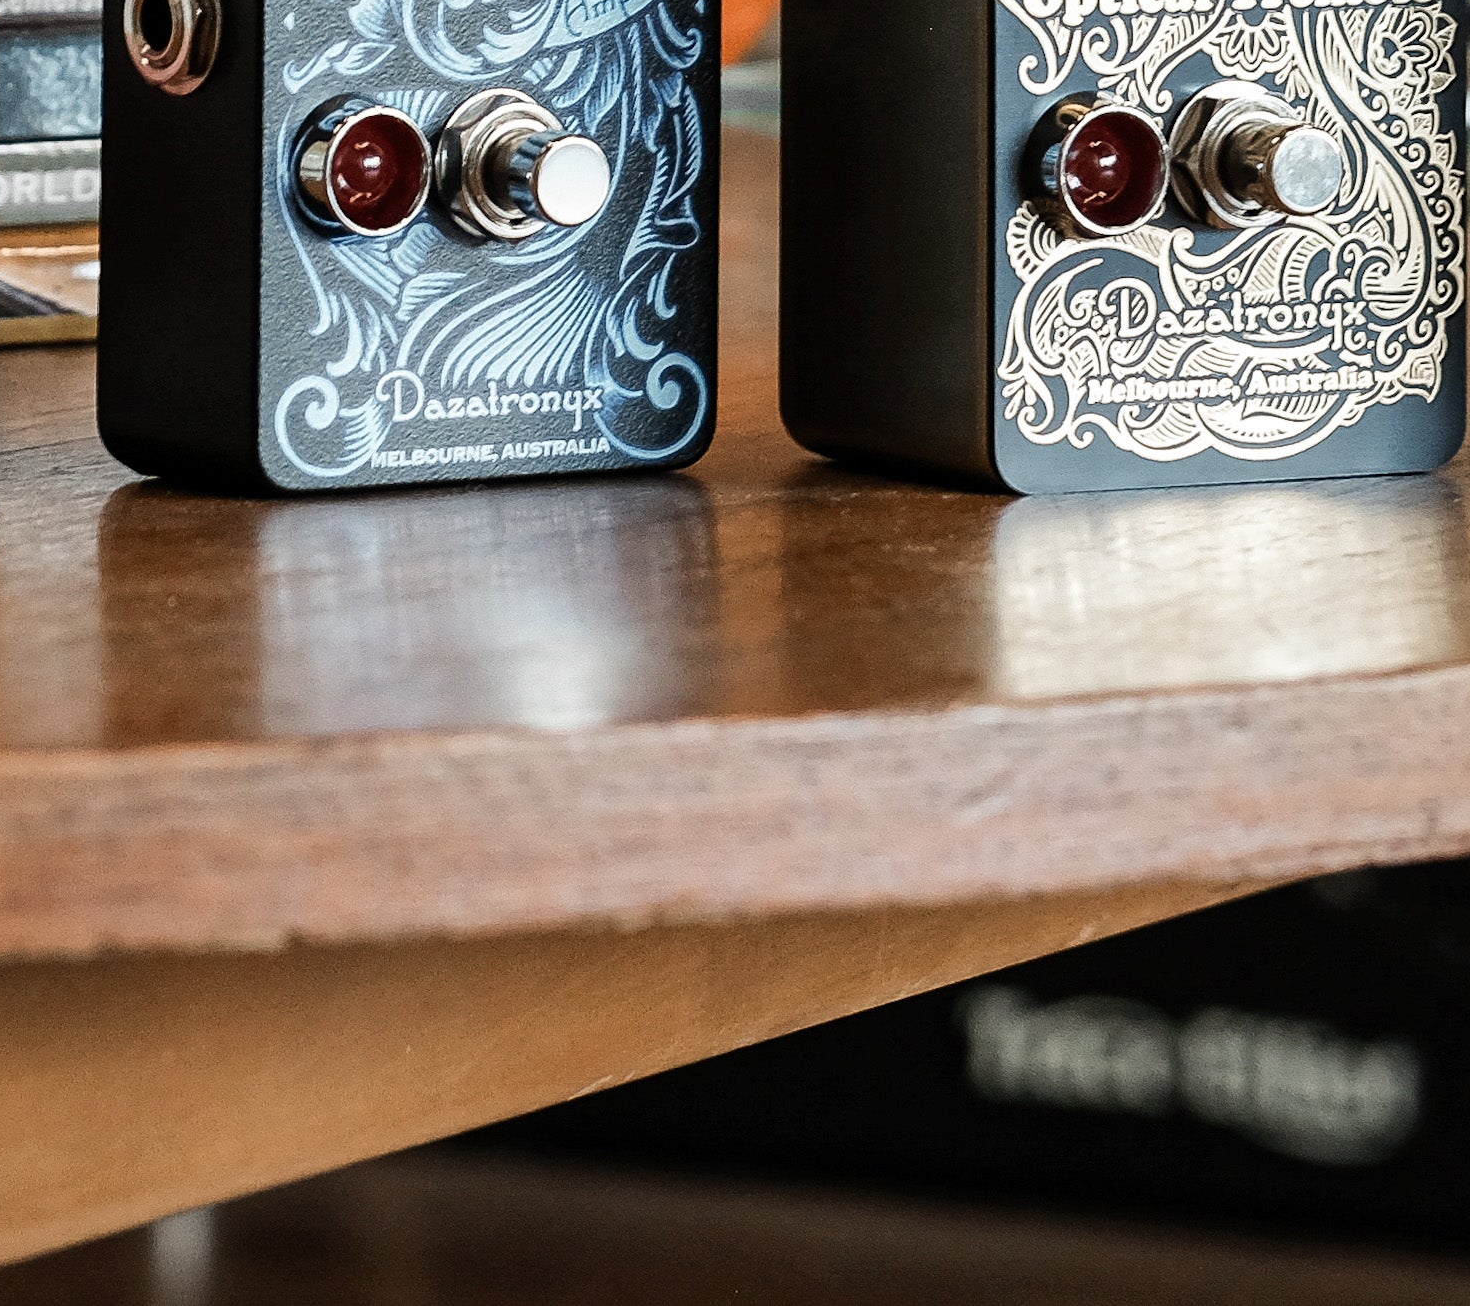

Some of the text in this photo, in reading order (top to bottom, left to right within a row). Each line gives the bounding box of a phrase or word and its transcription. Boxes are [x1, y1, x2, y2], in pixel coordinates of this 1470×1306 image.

[1098, 277, 1368, 348] Dazatronyx
[376, 370, 603, 431] Dazatronyx
[1087, 367, 1375, 406] Melbourne, Australia
[370, 437, 611, 470] MELBOURNE, AUSTRALIA
